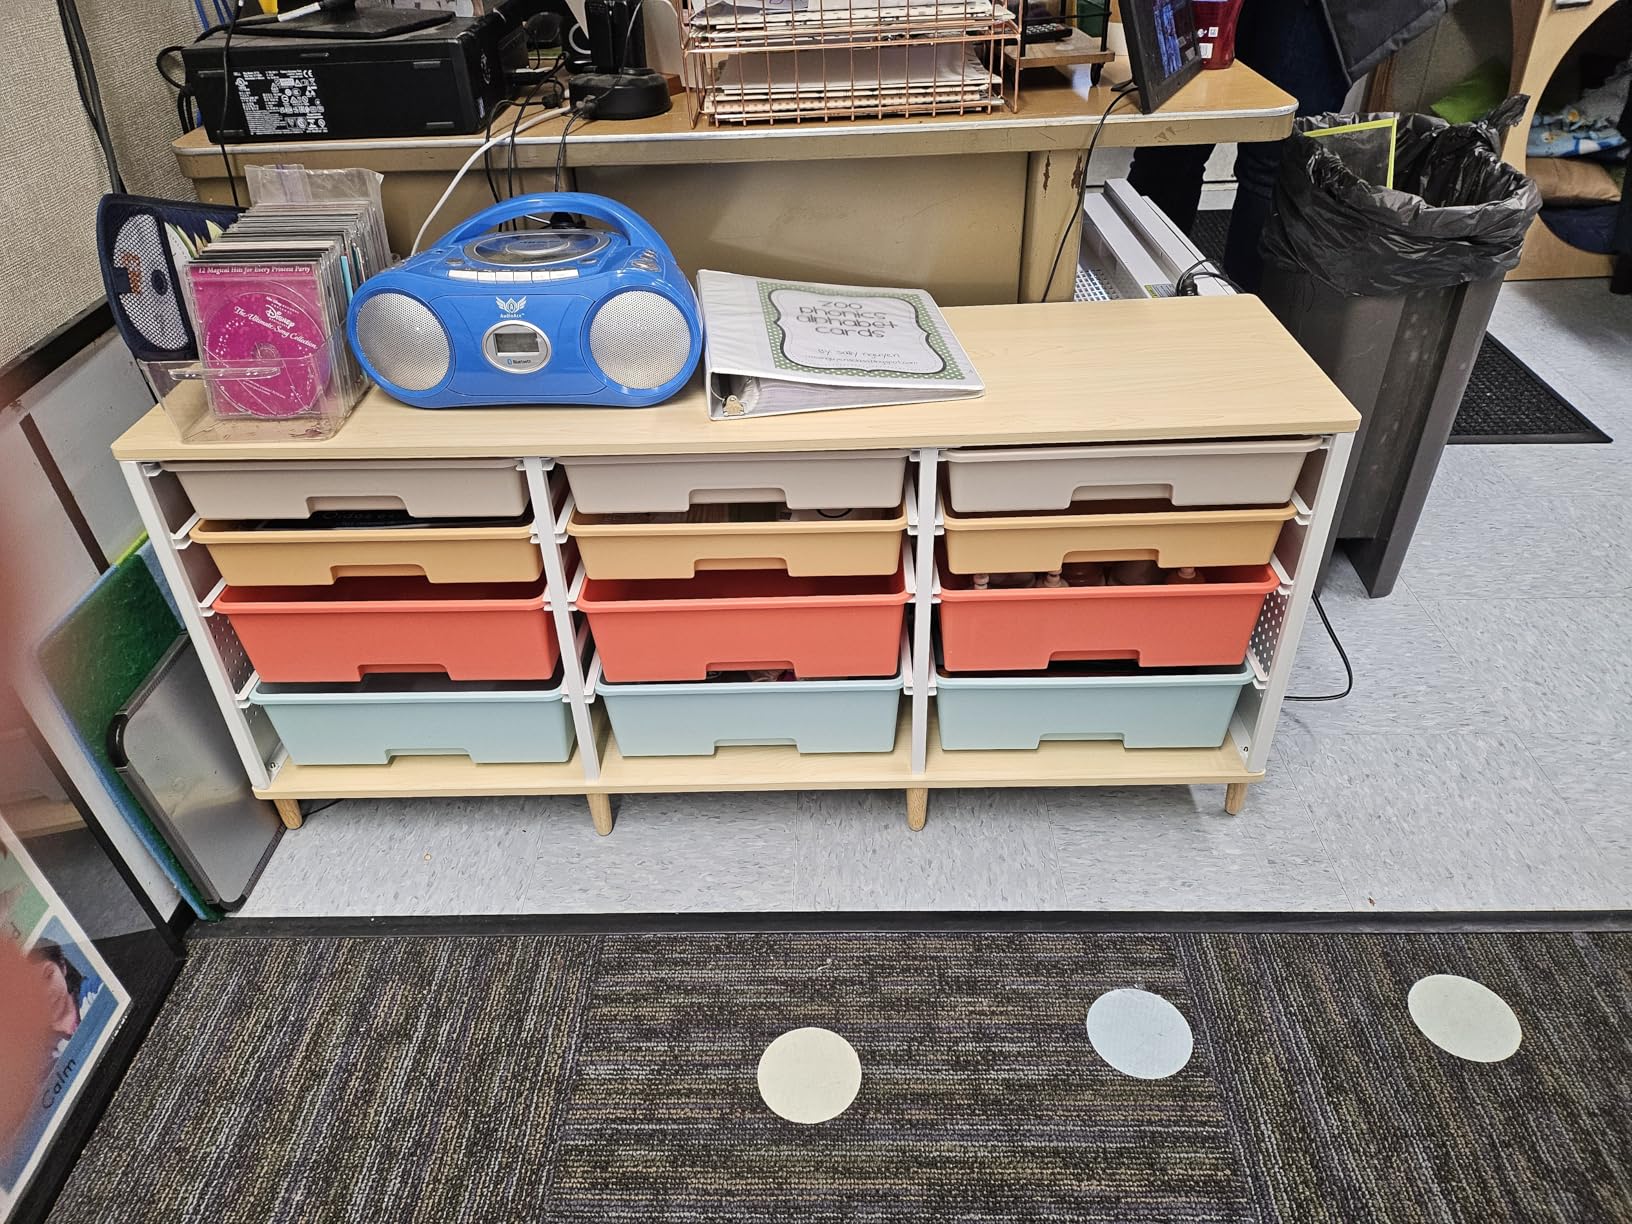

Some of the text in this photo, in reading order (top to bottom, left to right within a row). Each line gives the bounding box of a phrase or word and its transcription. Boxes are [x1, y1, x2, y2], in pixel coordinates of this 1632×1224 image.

[207, 267, 230, 276] Magical
[243, 267, 253, 275] for
[254, 266, 270, 275] Every
[294, 265, 311, 275] Party
[234, 305, 246, 317] The
[247, 312, 273, 330] Ultimate
[273, 326, 289, 339] Song
[289, 332, 319, 350] Collection
[796, 314, 899, 329] alphabet
[815, 326, 886, 338] cards
[42, 1058, 77, 1109] Calm
